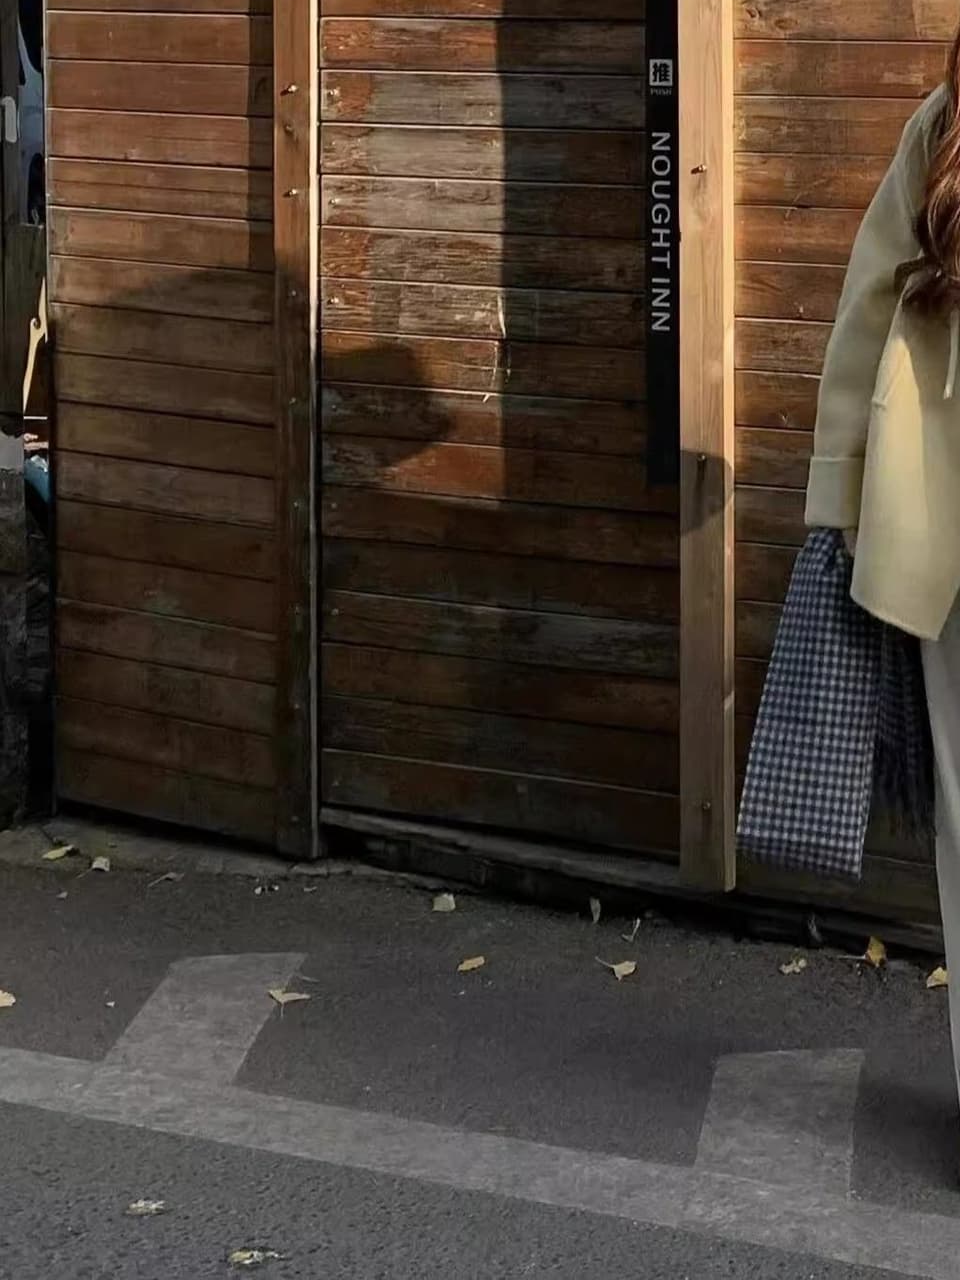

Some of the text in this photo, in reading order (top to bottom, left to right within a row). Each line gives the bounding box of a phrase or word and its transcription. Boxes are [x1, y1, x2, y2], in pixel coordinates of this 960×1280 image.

[652, 61, 671, 83] 推
[651, 132, 671, 332] NOUGHT INN
